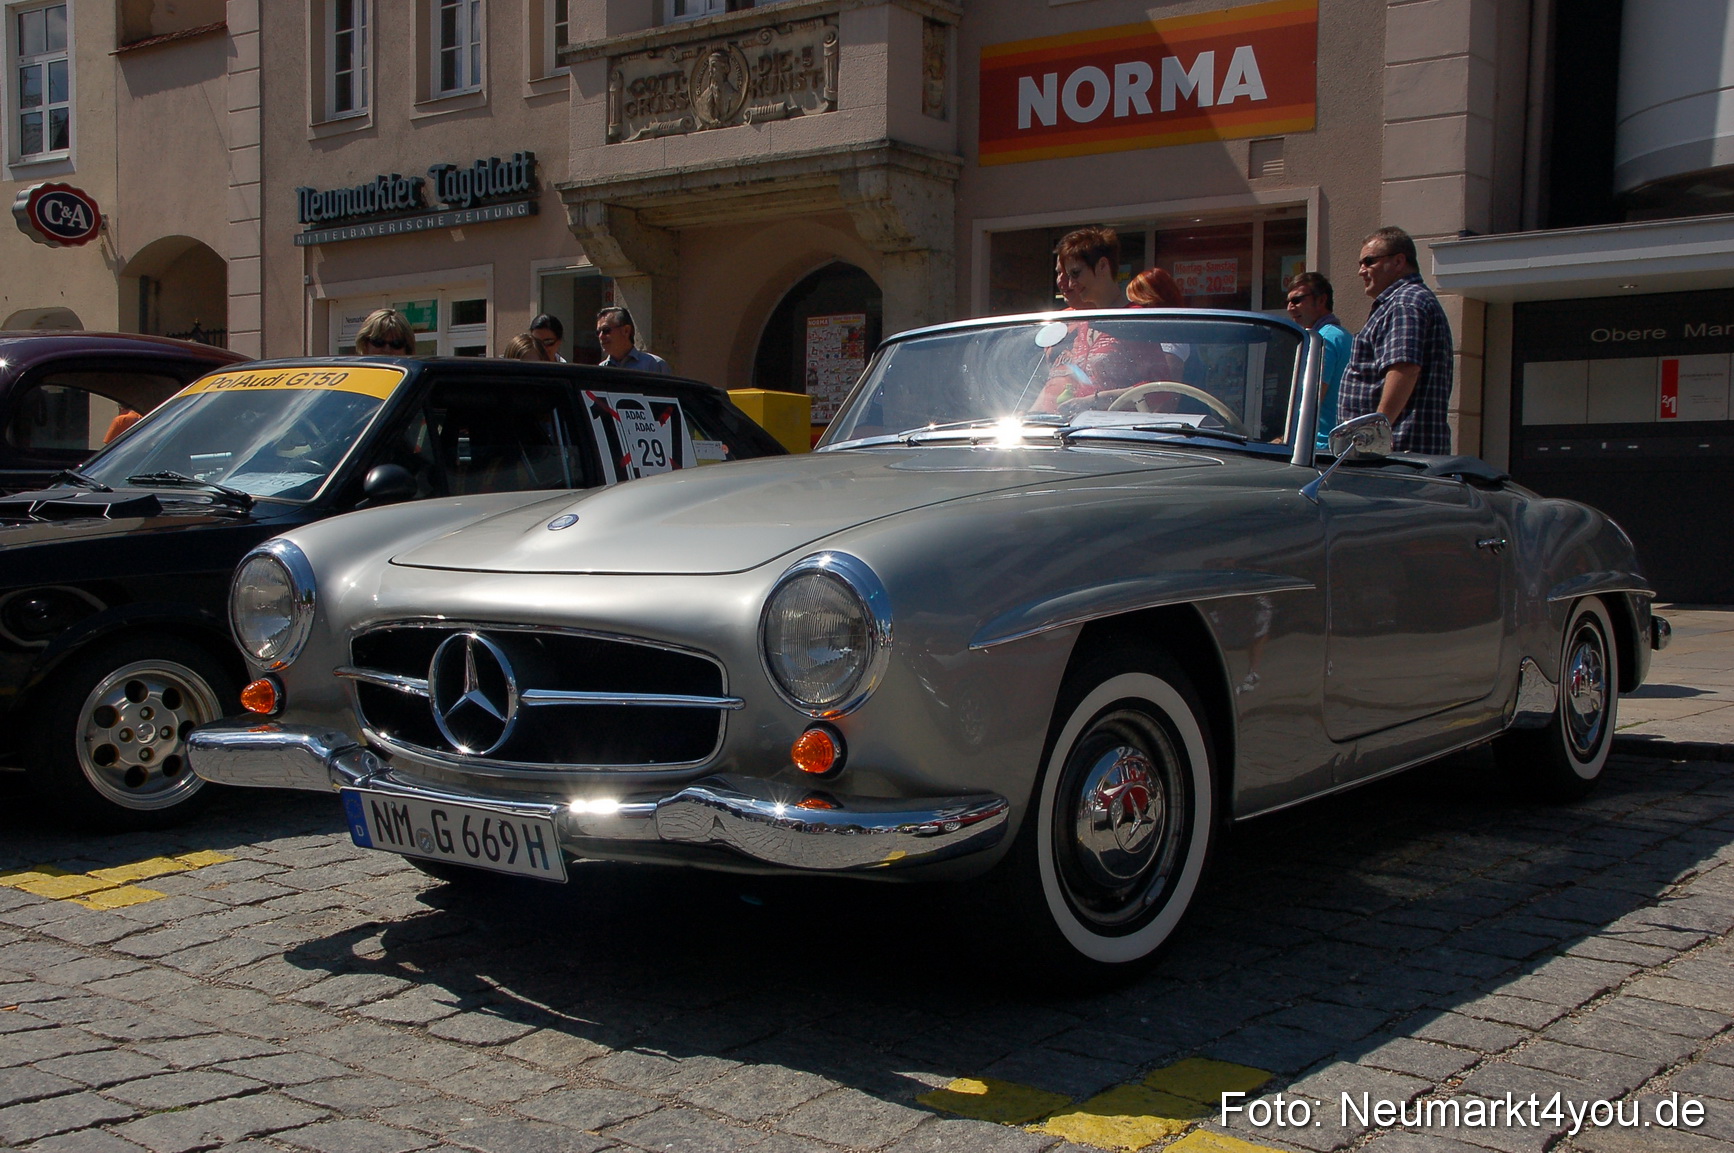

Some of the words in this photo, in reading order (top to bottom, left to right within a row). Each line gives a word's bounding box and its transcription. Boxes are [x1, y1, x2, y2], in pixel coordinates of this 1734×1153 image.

[1017, 44, 1268, 130] NORMA
[296, 172, 424, 223] Neumarkter
[427, 150, 532, 208] Tagblatt
[44, 199, 89, 230] C&A
[297, 214, 446, 245] MITTELBAYERISCHE
[455, 204, 526, 224] ZEITUNG
[1591, 327, 1667, 343] Obere
[203, 373, 290, 391] PolAudi
[285, 372, 350, 387] GT50
[625, 410, 647, 421] ADAC
[635, 422, 657, 433] ADAC
[589, 396, 683, 485] 17
[638, 438, 667, 468] 29
[370, 799, 416, 848] NM
[430, 808, 456, 855] G
[461, 814, 551, 871] 669H
